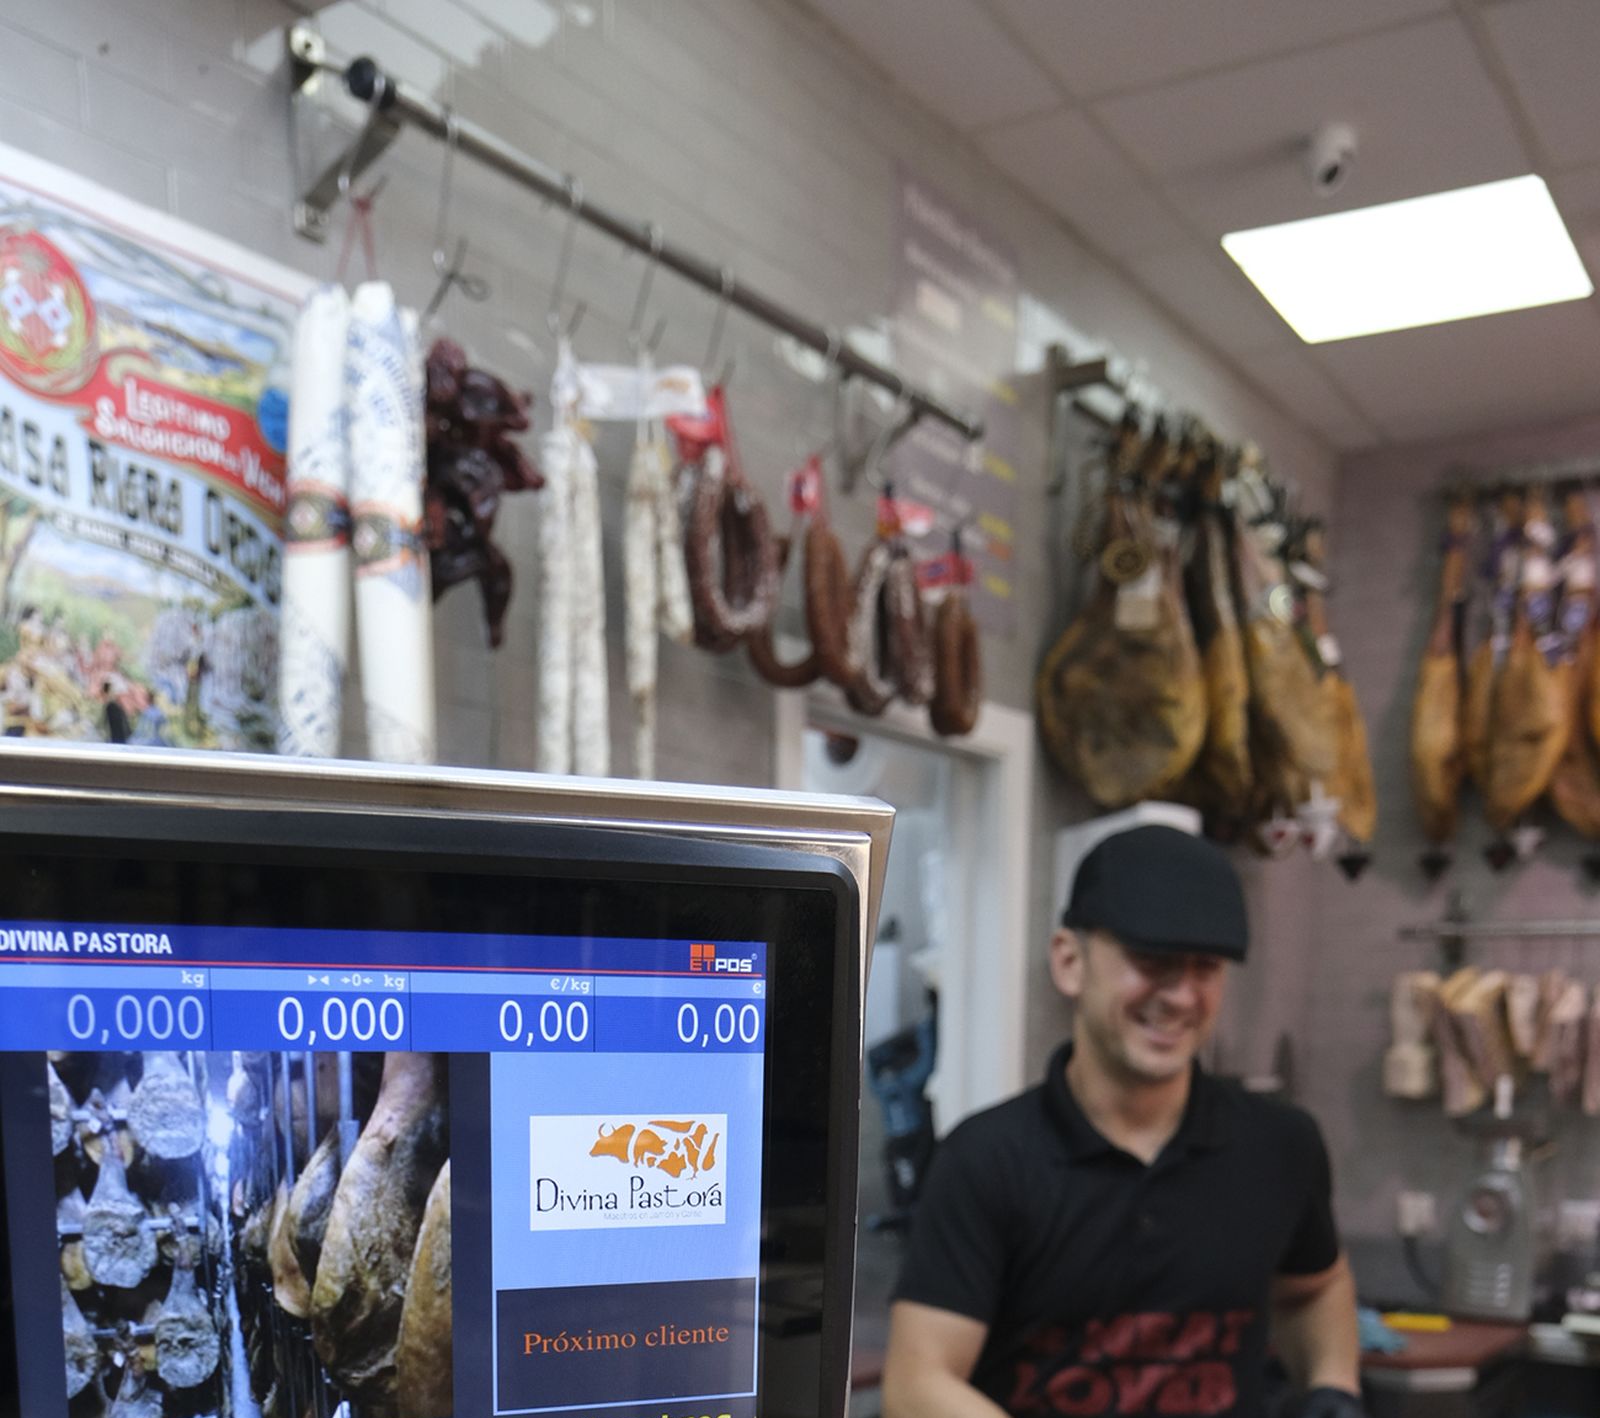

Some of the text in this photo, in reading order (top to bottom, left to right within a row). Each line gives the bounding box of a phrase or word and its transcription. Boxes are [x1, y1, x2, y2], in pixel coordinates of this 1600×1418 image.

[0, 929, 173, 954] DIVINA PASTORA
[181, 971, 204, 986] kg
[384, 974, 405, 990] kg
[550, 977, 591, 994] €/kg
[67, 994, 205, 1045] 0,000
[278, 997, 404, 1045] 0,000
[500, 1000, 589, 1047] 0,00
[677, 1003, 760, 1048] 0,00
[536, 1178, 618, 1212] Divina
[524, 1324, 729, 1355] Próximo cliente
